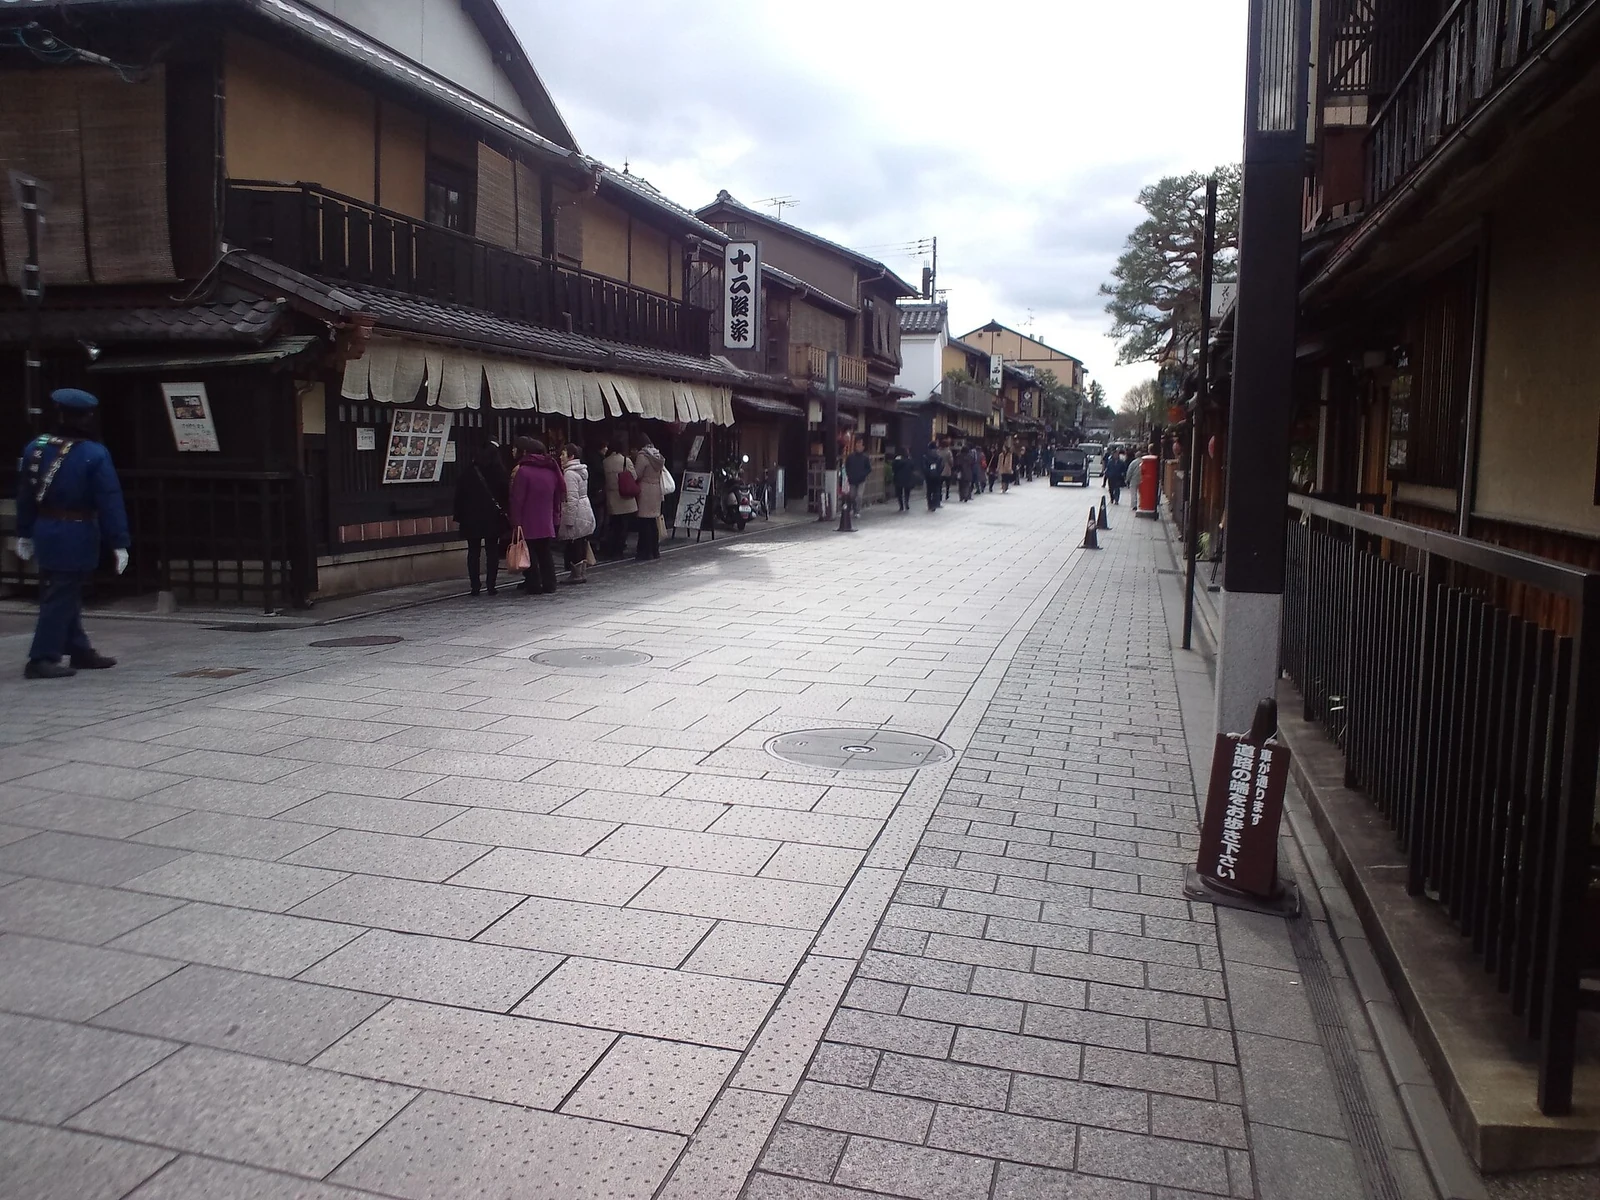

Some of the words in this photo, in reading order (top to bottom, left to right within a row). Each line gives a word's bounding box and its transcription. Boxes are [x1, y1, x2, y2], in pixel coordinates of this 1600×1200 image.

[1217, 742, 1256, 879] 道路の端をお歩き下さい
[1251, 748, 1273, 826] 車が通ります
